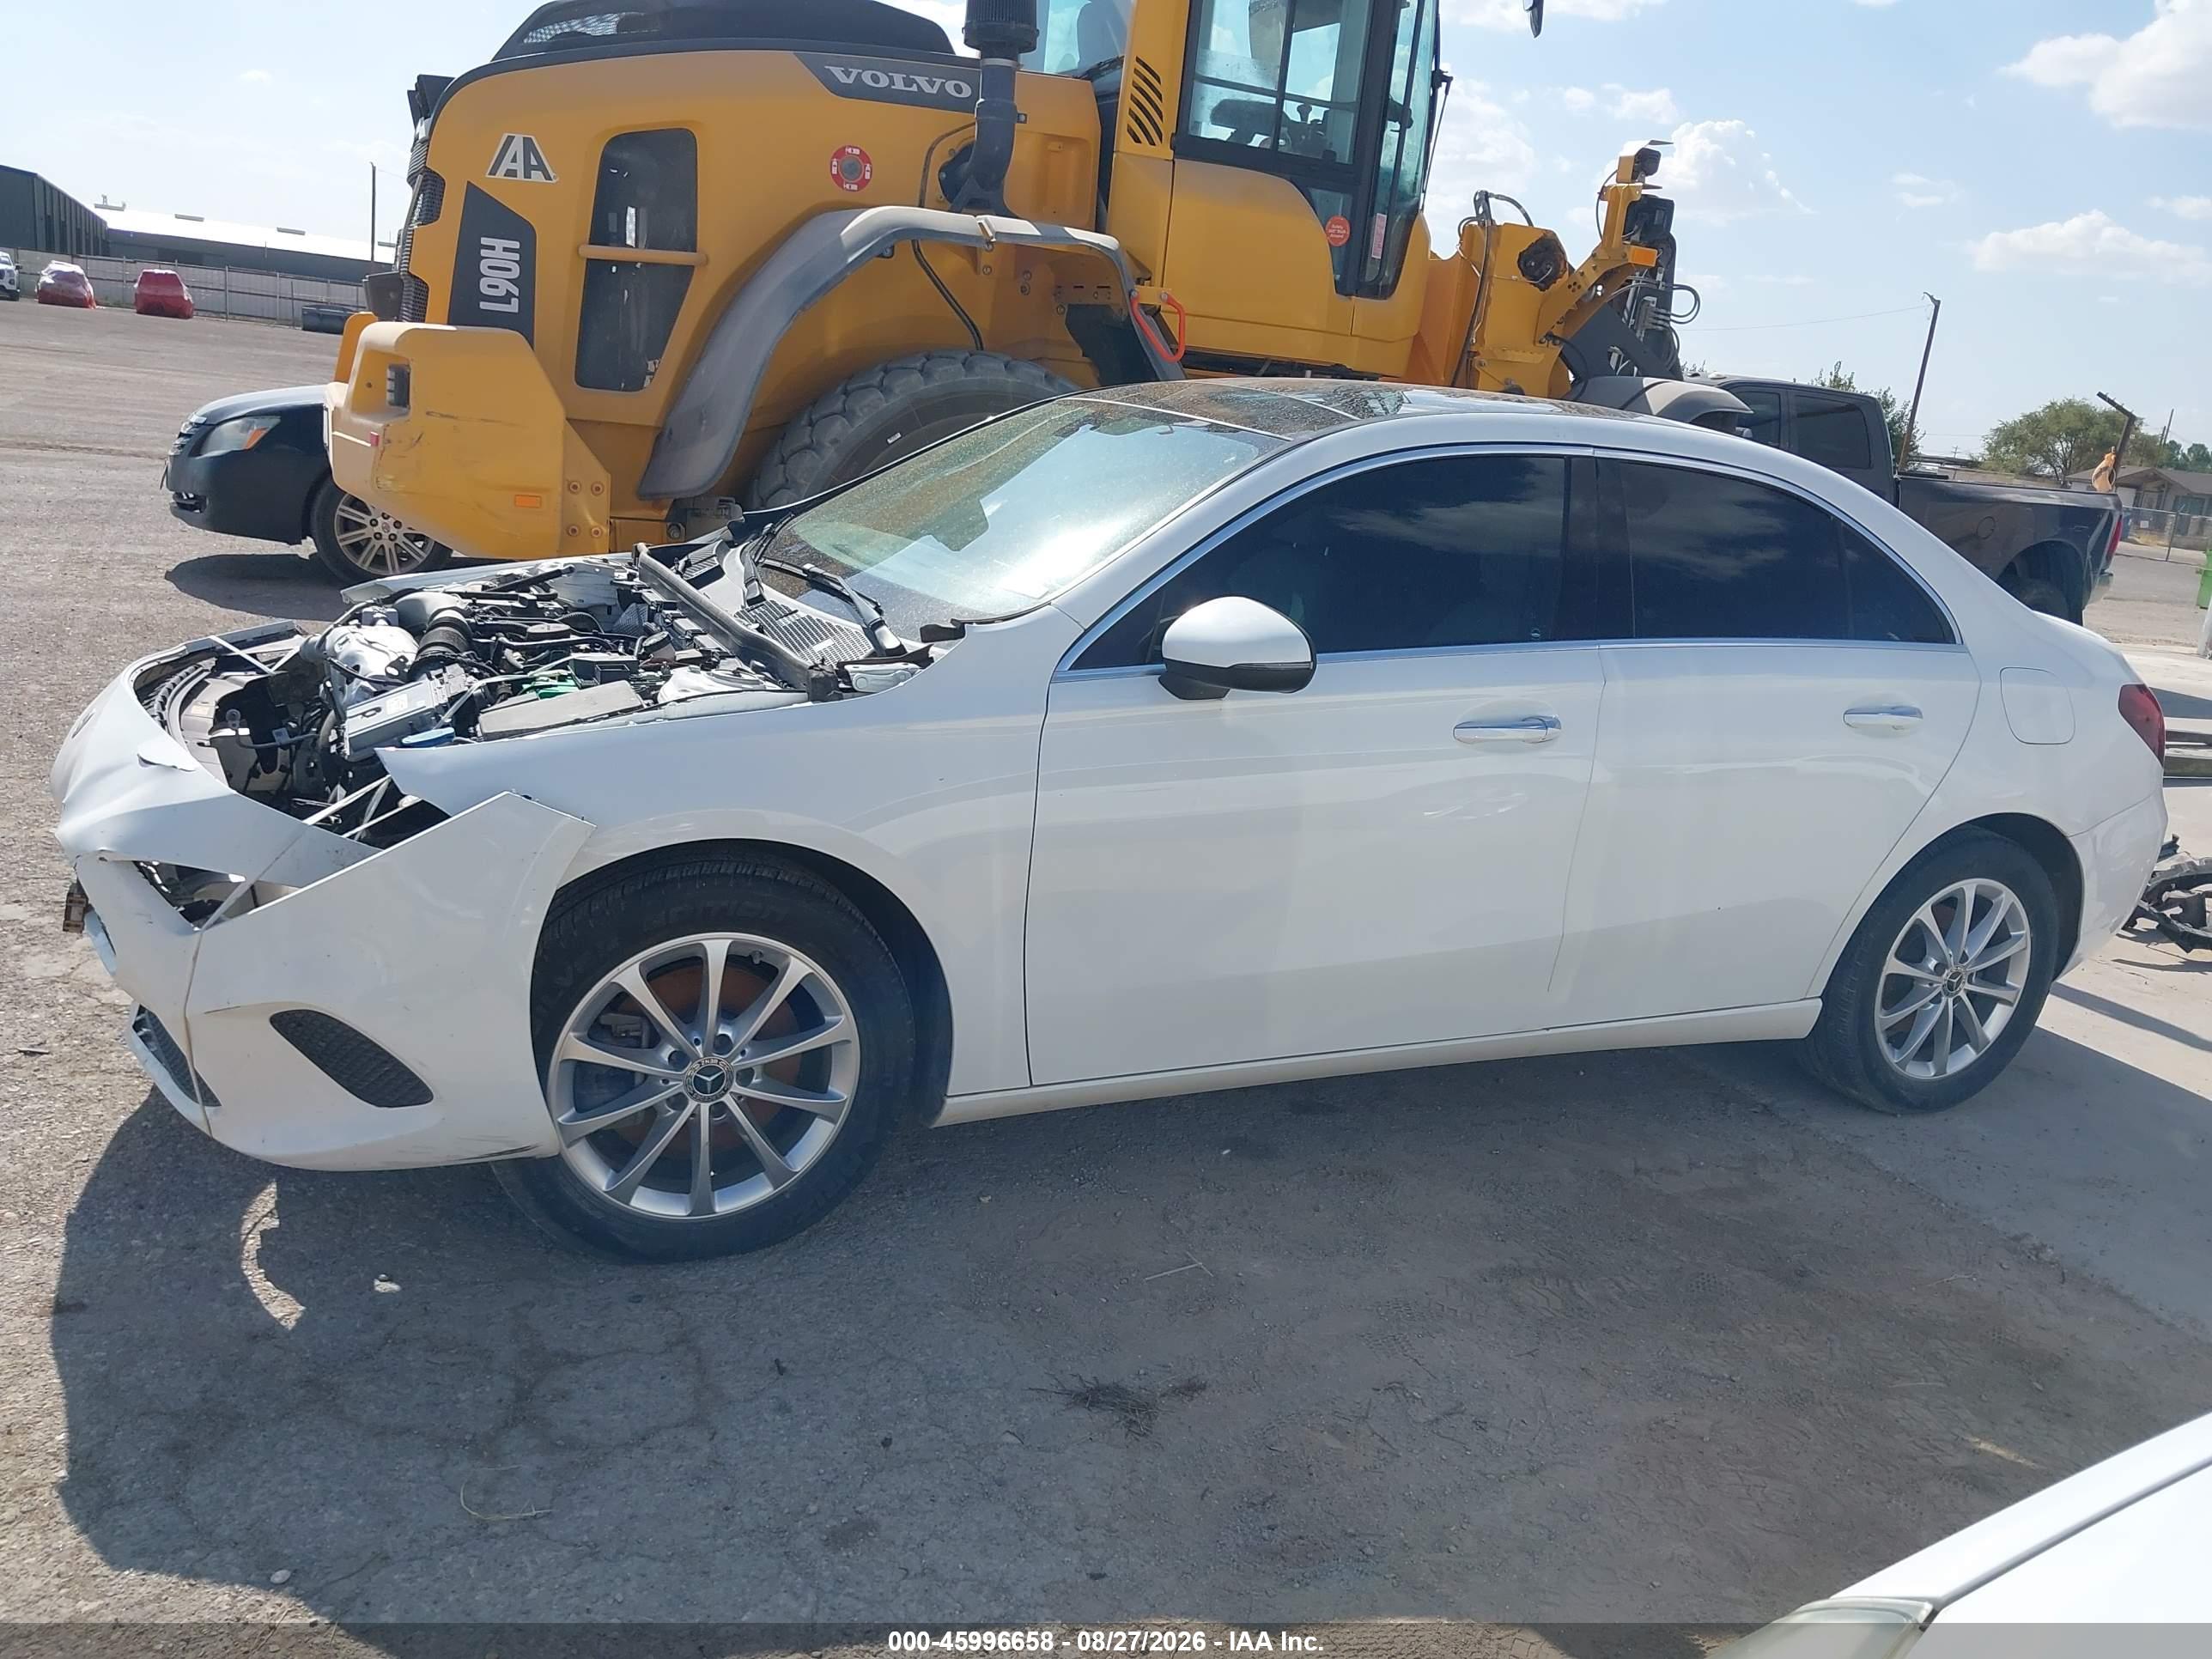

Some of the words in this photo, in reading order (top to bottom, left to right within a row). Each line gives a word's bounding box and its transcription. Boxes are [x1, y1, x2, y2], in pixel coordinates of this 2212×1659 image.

[824, 65, 972, 98] VOLVO
[487, 134, 554, 182] IAA
[479, 236, 520, 313] L90H
